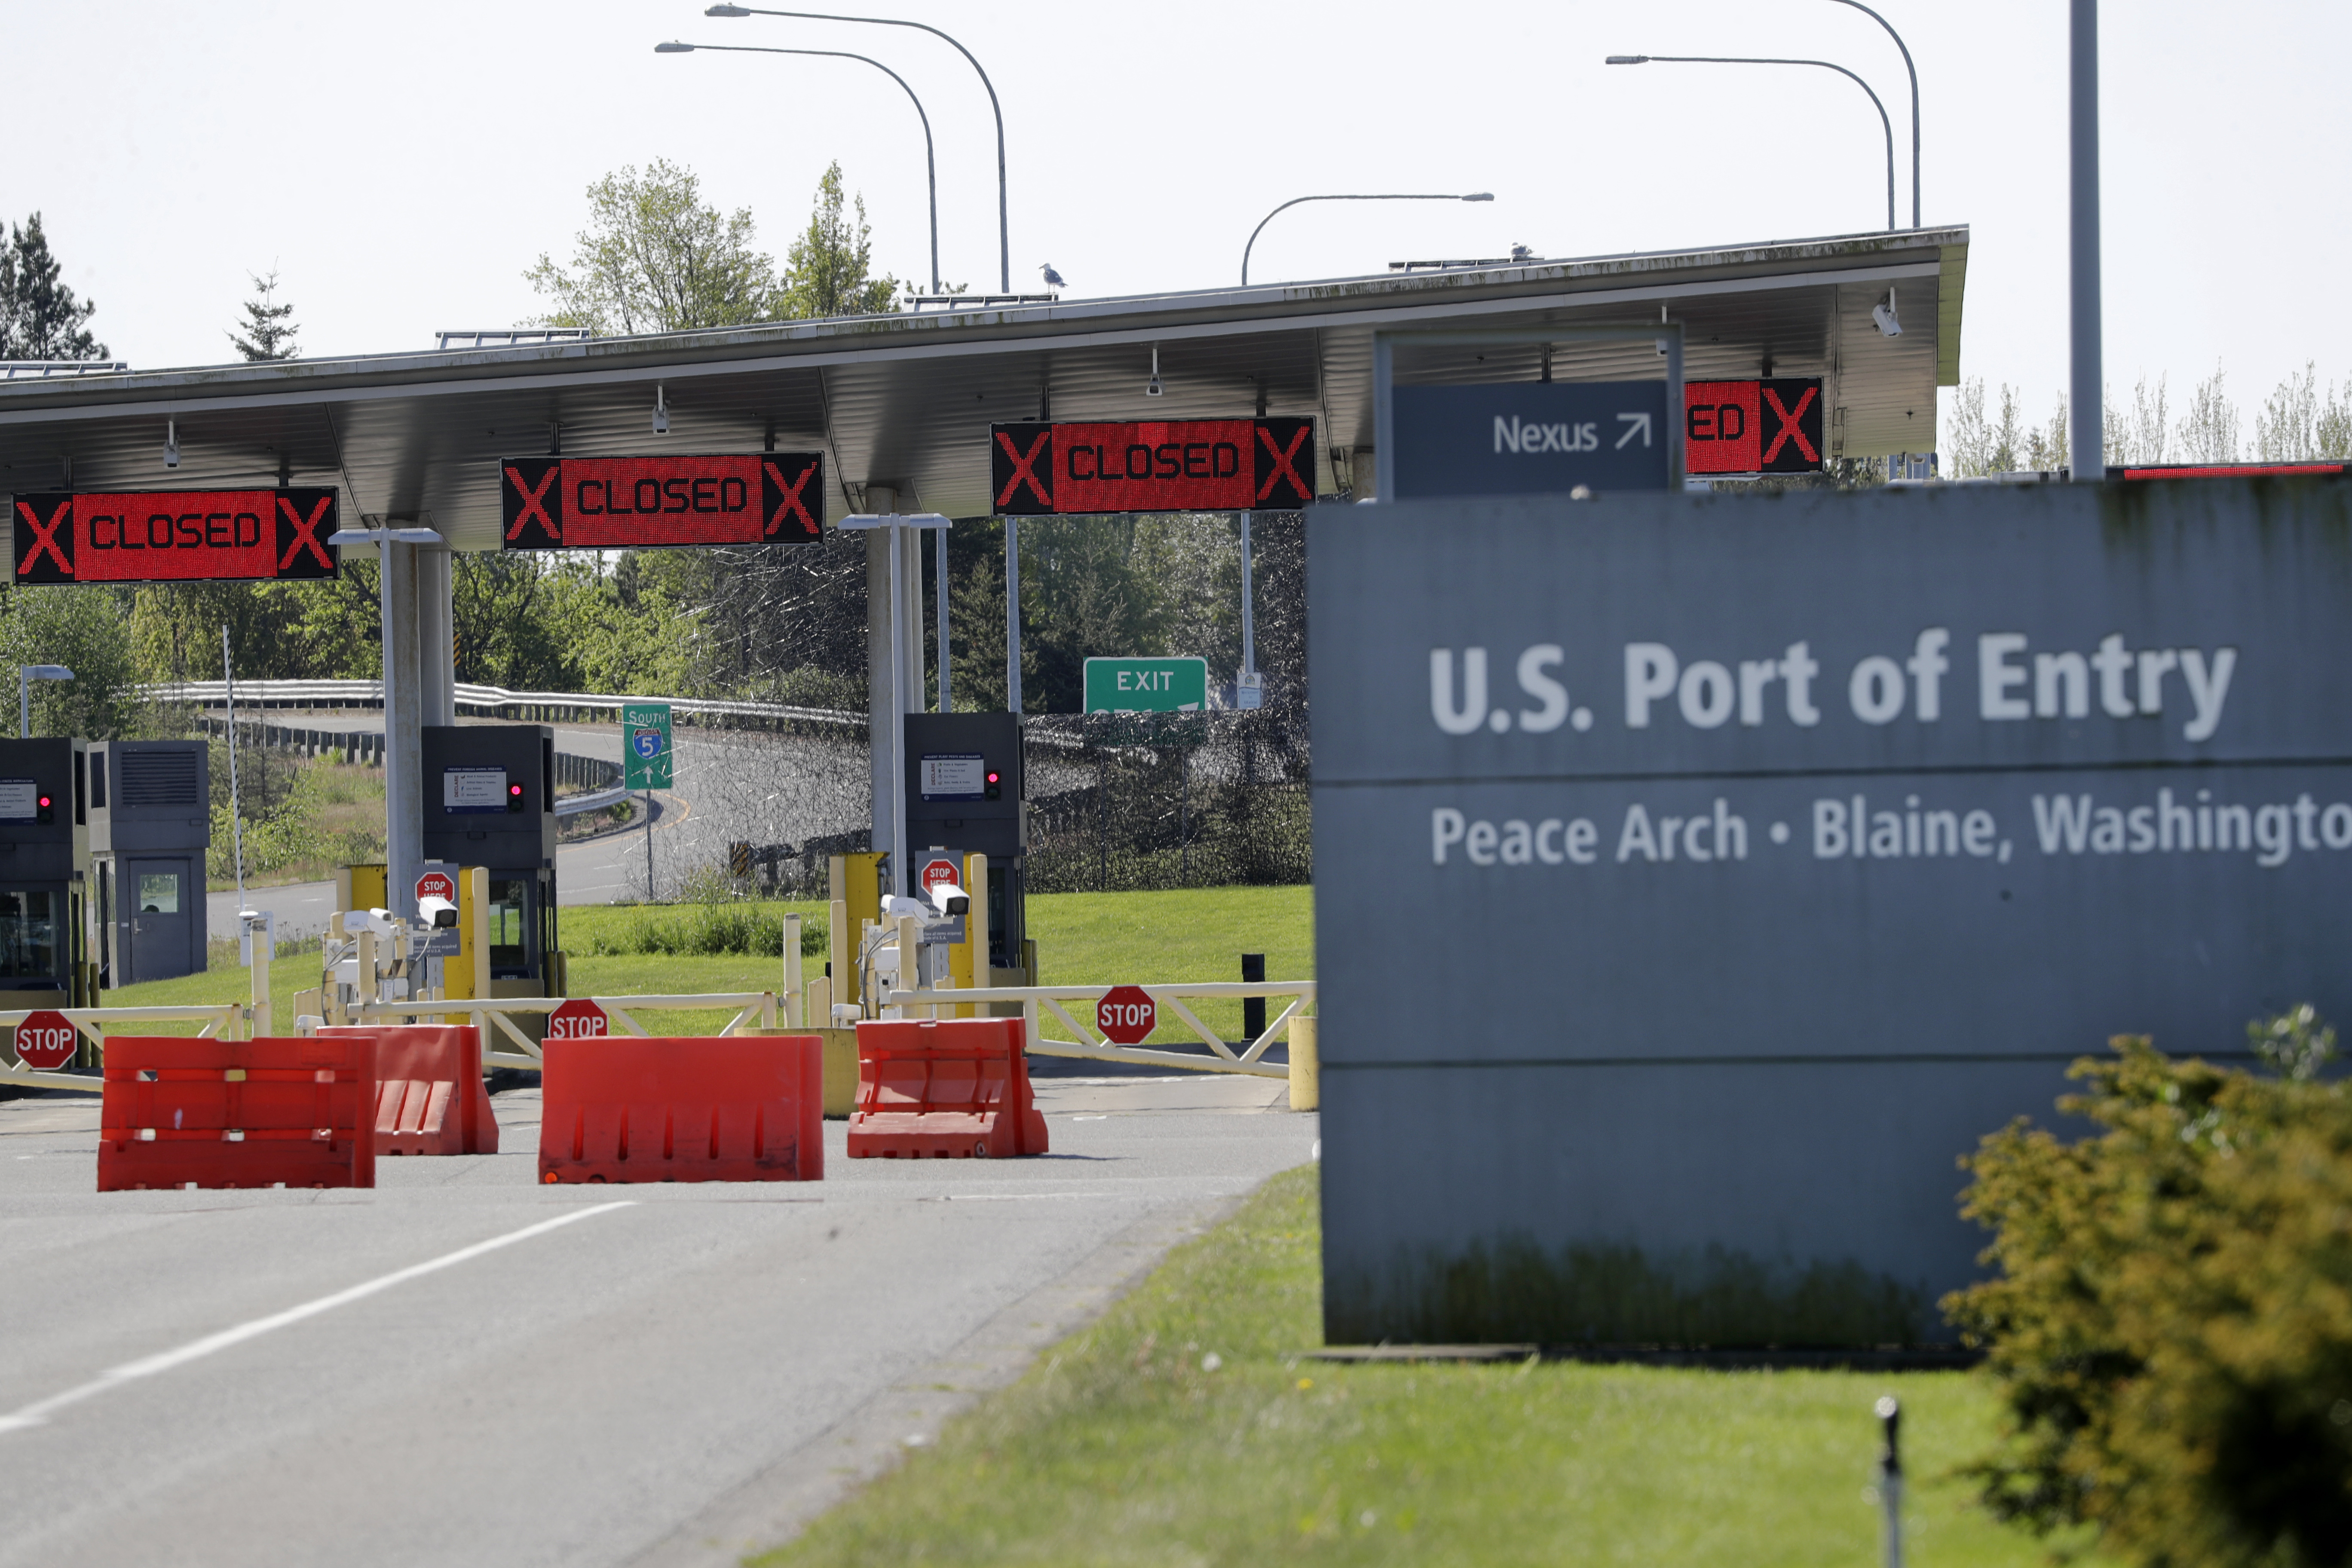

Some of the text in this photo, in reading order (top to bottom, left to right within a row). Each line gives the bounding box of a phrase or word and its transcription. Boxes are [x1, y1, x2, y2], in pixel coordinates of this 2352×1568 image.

[1494, 415, 1599, 453] Nexus
[1068, 442, 1239, 481] CLOSED
[577, 477, 747, 515] CLOSED
[89, 512, 261, 550] CLOSED
[1117, 671, 1174, 691] EXIT
[1430, 628, 2236, 741] U.S. Port of Entry
[629, 710, 666, 723] SOUTH
[642, 737, 653, 756] 5
[1432, 808, 1598, 865] Peace
[1616, 798, 1748, 862] Arch
[1813, 794, 2012, 863] Blaine,
[930, 868, 950, 878] STOP
[424, 881, 445, 891] STOP
[1100, 1004, 1152, 1026] STOP
[553, 1016, 605, 1038] STOP
[19, 1028, 72, 1051] STOP
